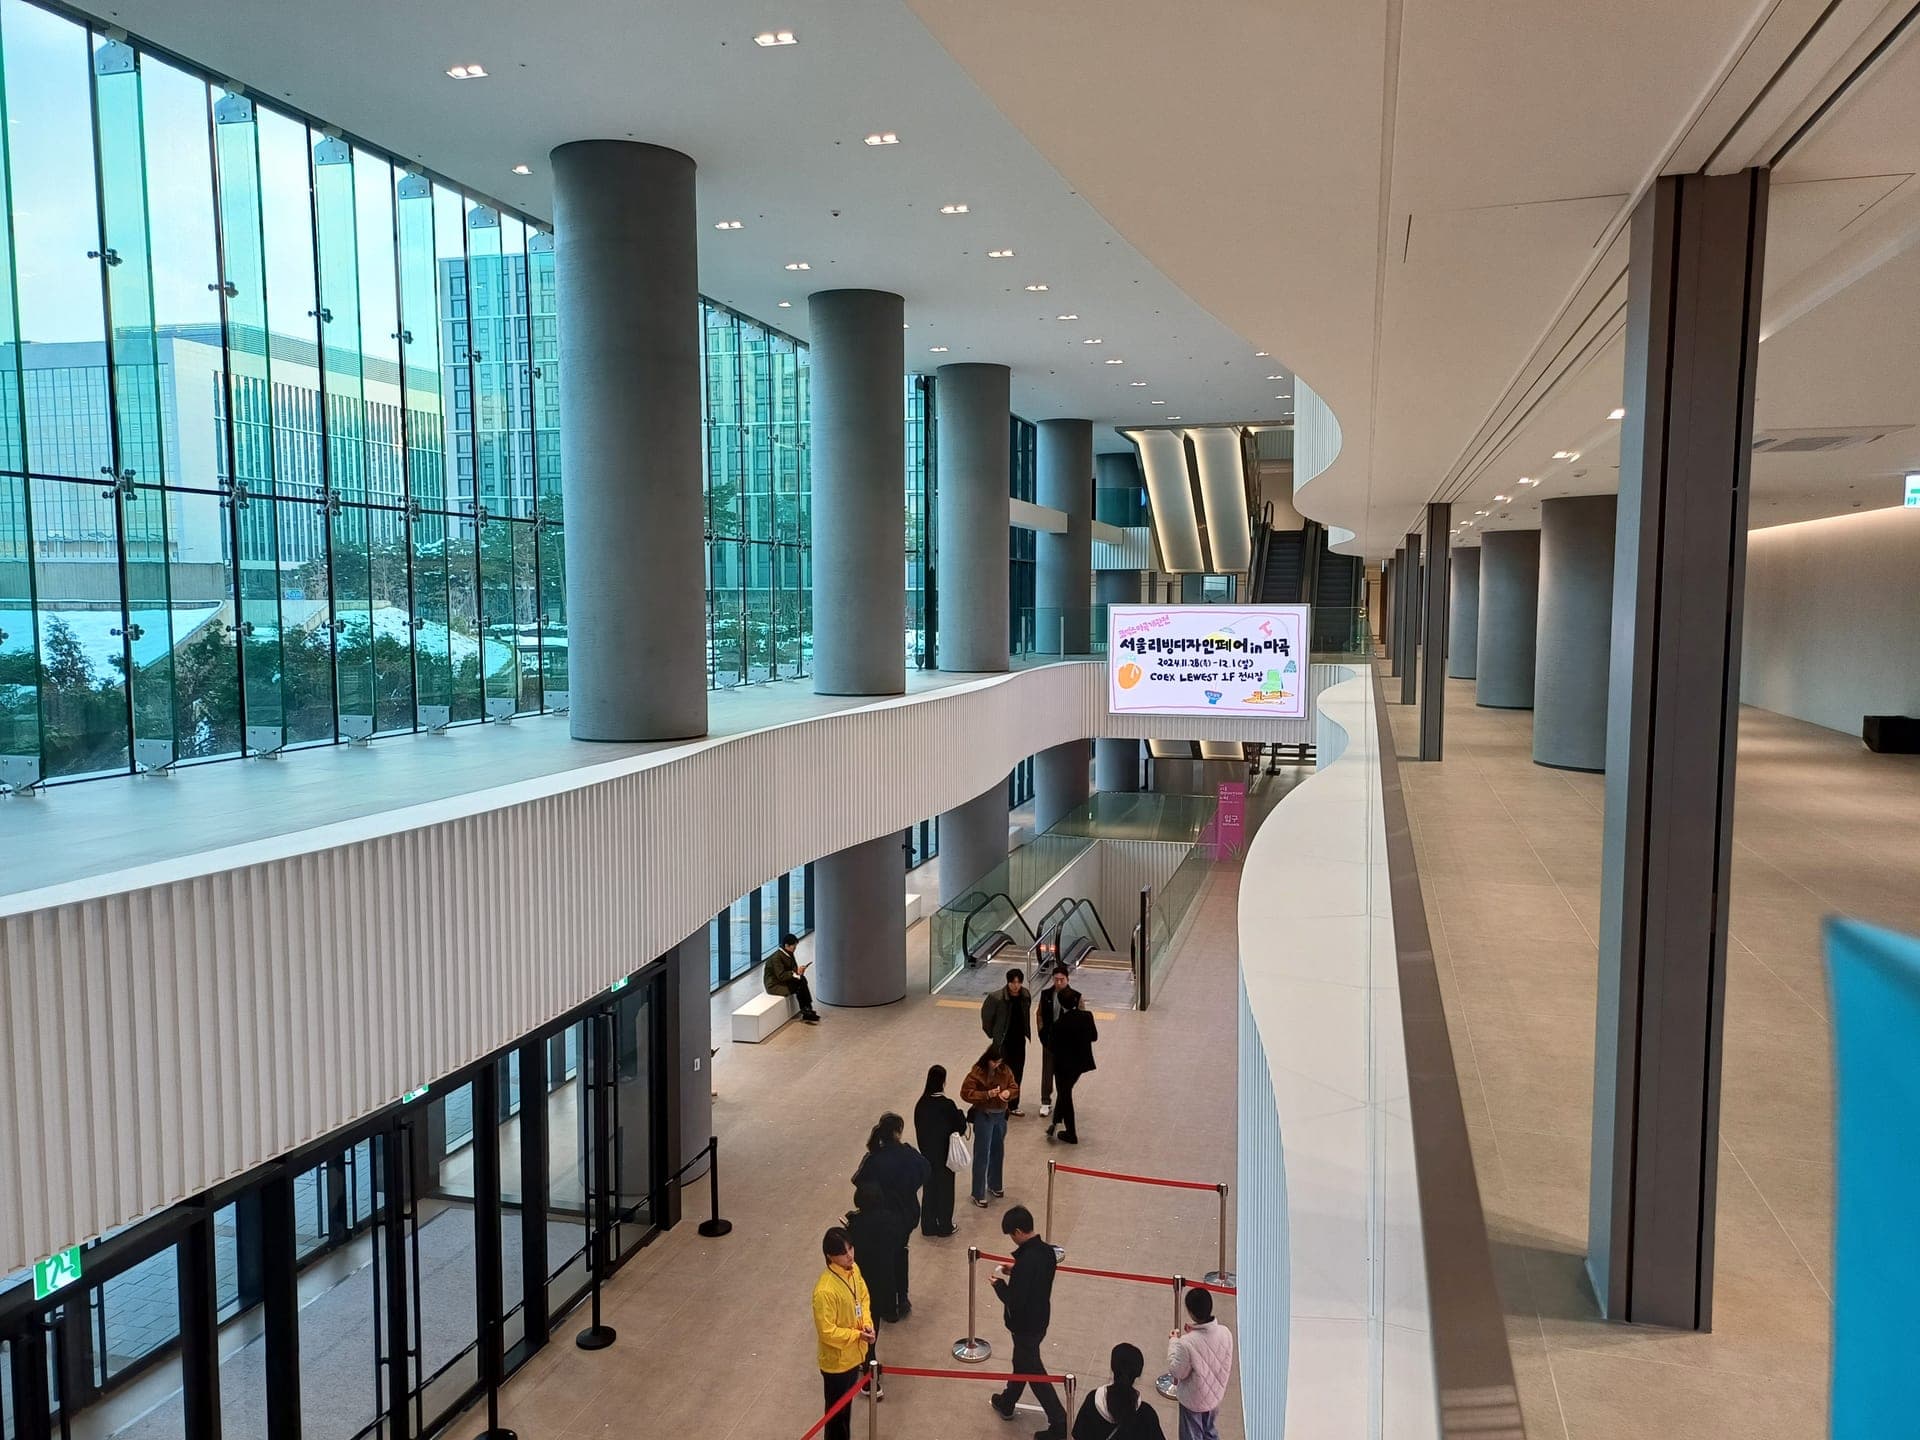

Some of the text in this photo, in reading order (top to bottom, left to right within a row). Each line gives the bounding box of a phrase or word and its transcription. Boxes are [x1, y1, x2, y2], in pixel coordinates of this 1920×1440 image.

[1150, 671, 1263, 682] COEX LEWEST 1F 전시장
[1224, 814, 1238, 823] 입구
